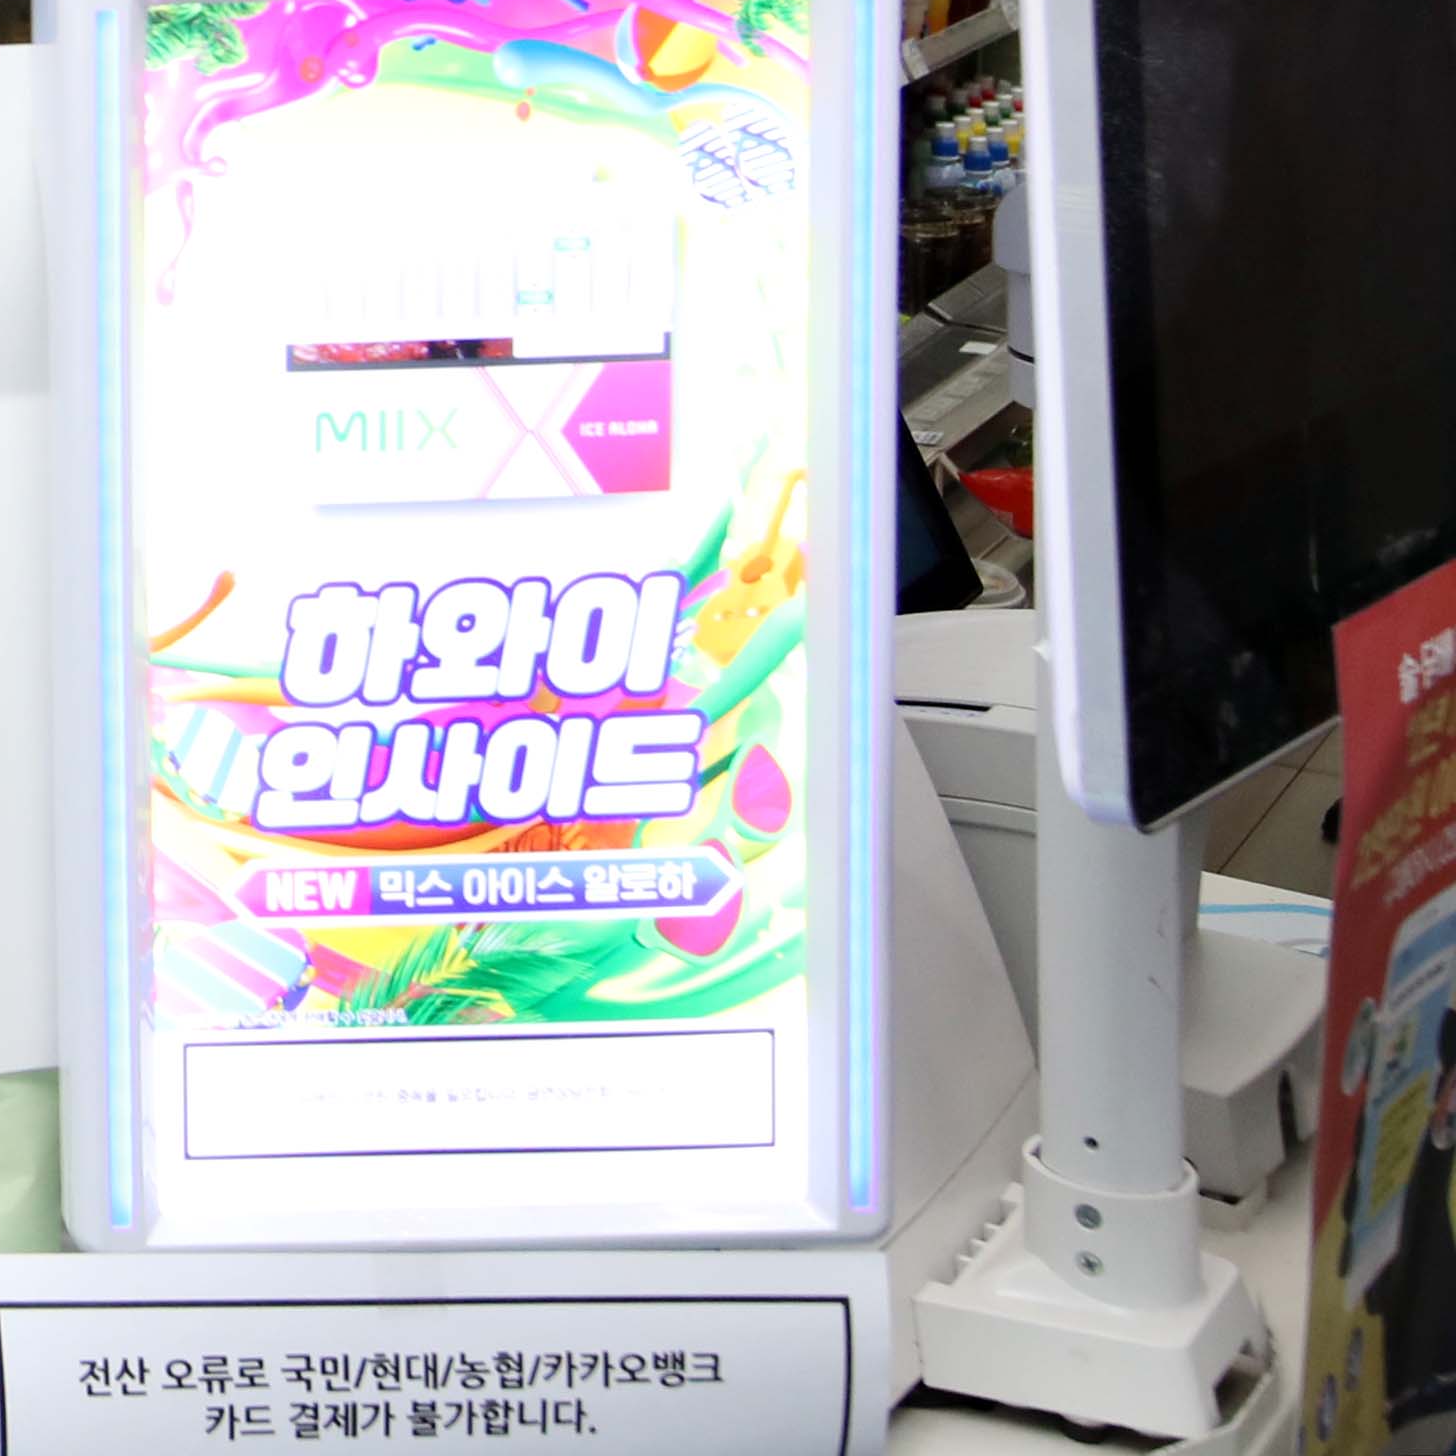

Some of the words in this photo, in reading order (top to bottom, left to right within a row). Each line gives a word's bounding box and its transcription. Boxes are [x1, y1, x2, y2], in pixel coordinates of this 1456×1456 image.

[314, 406, 460, 453] MIIX
[279, 570, 687, 707] 하와이
[265, 868, 357, 912] NEW
[377, 872, 452, 907] 믹스
[463, 869, 575, 905] 아이스
[584, 861, 697, 904] 알로하
[79, 1359, 150, 1395] 전산
[162, 1356, 270, 1394] 오류로
[281, 1351, 725, 1393] 국민/현대/농협/카카오뱅크
[206, 1405, 276, 1441] 카드
[289, 1401, 394, 1438] 결제가
[408, 1398, 598, 1437] 불가합니다.
